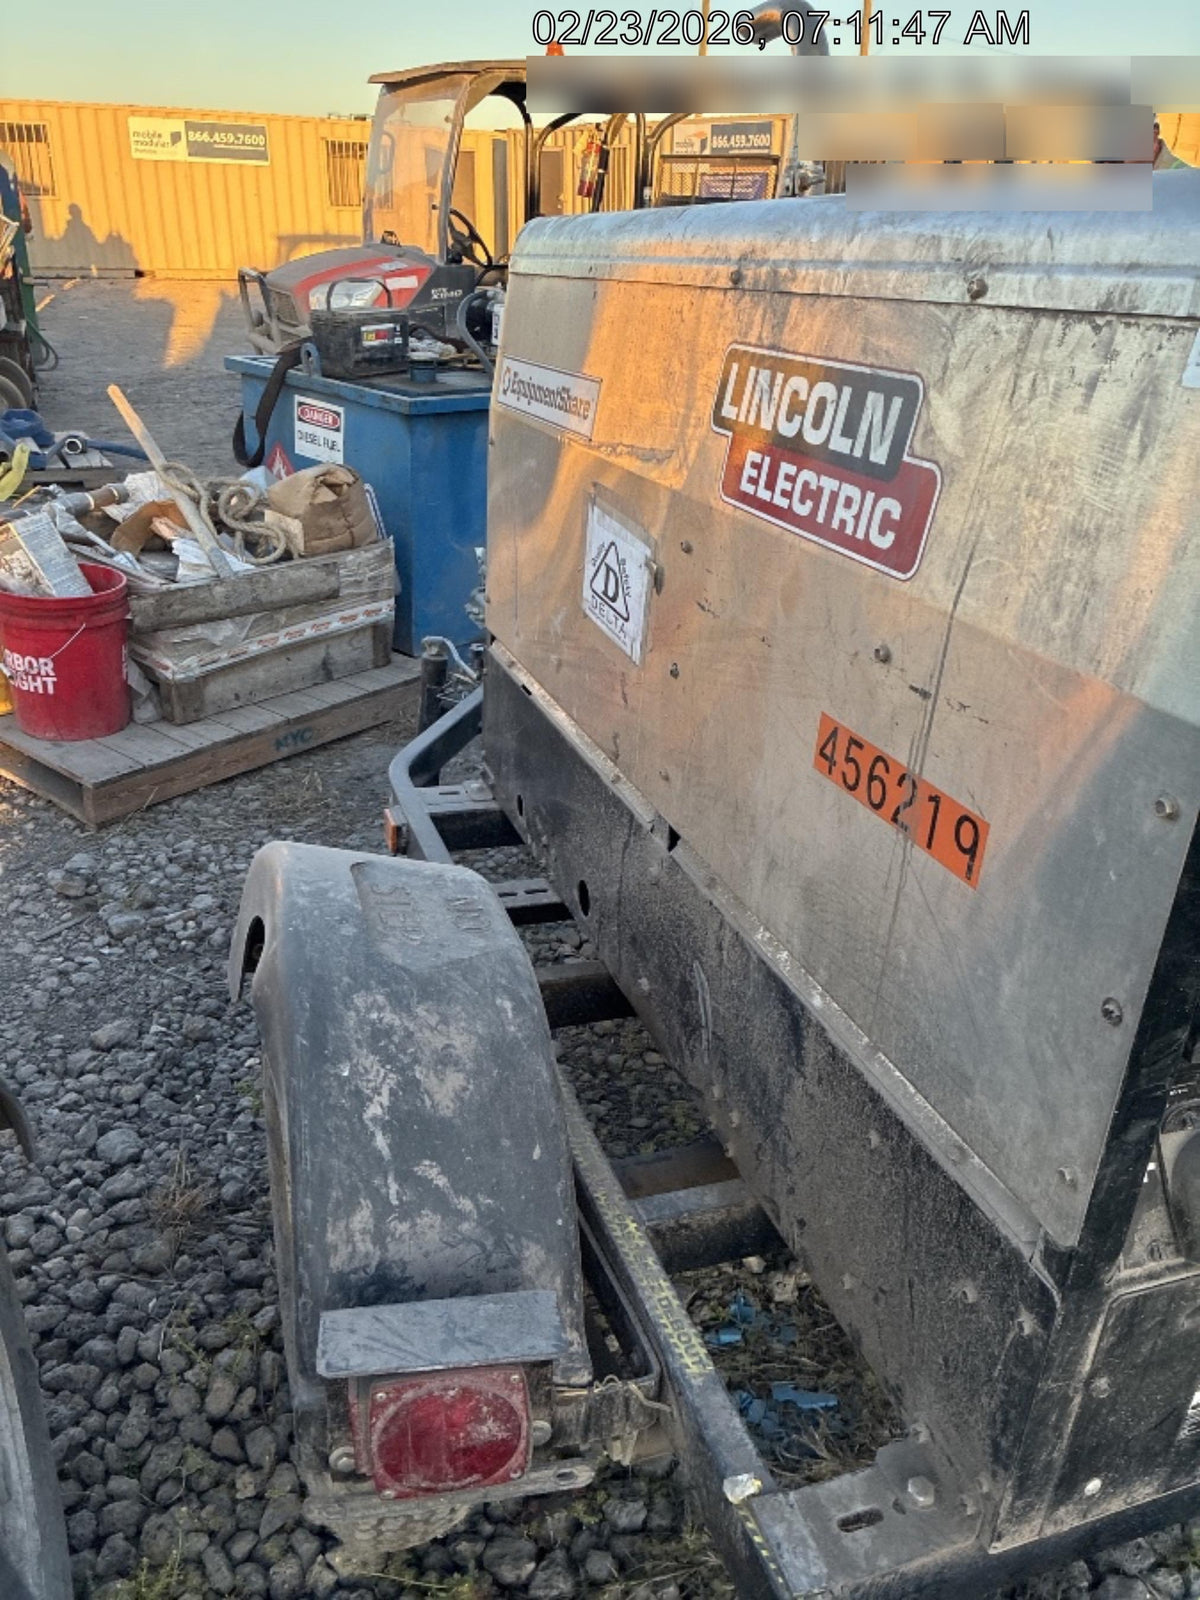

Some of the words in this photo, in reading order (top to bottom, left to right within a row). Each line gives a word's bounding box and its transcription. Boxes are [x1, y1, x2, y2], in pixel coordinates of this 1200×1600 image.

[188, 130, 266, 147] 866.459.7600
[510, 371, 591, 420] EquipmentShare
[721, 362, 904, 465] LINCOLN
[297, 429, 322, 447] DIESEL
[323, 436, 341, 452] FUEL
[739, 449, 902, 550] ELECTRIC
[601, 561, 620, 603] D
[591, 595, 628, 639] DELTA
[4, 648, 56, 677] RBOR
[818, 726, 980, 881] 456219
